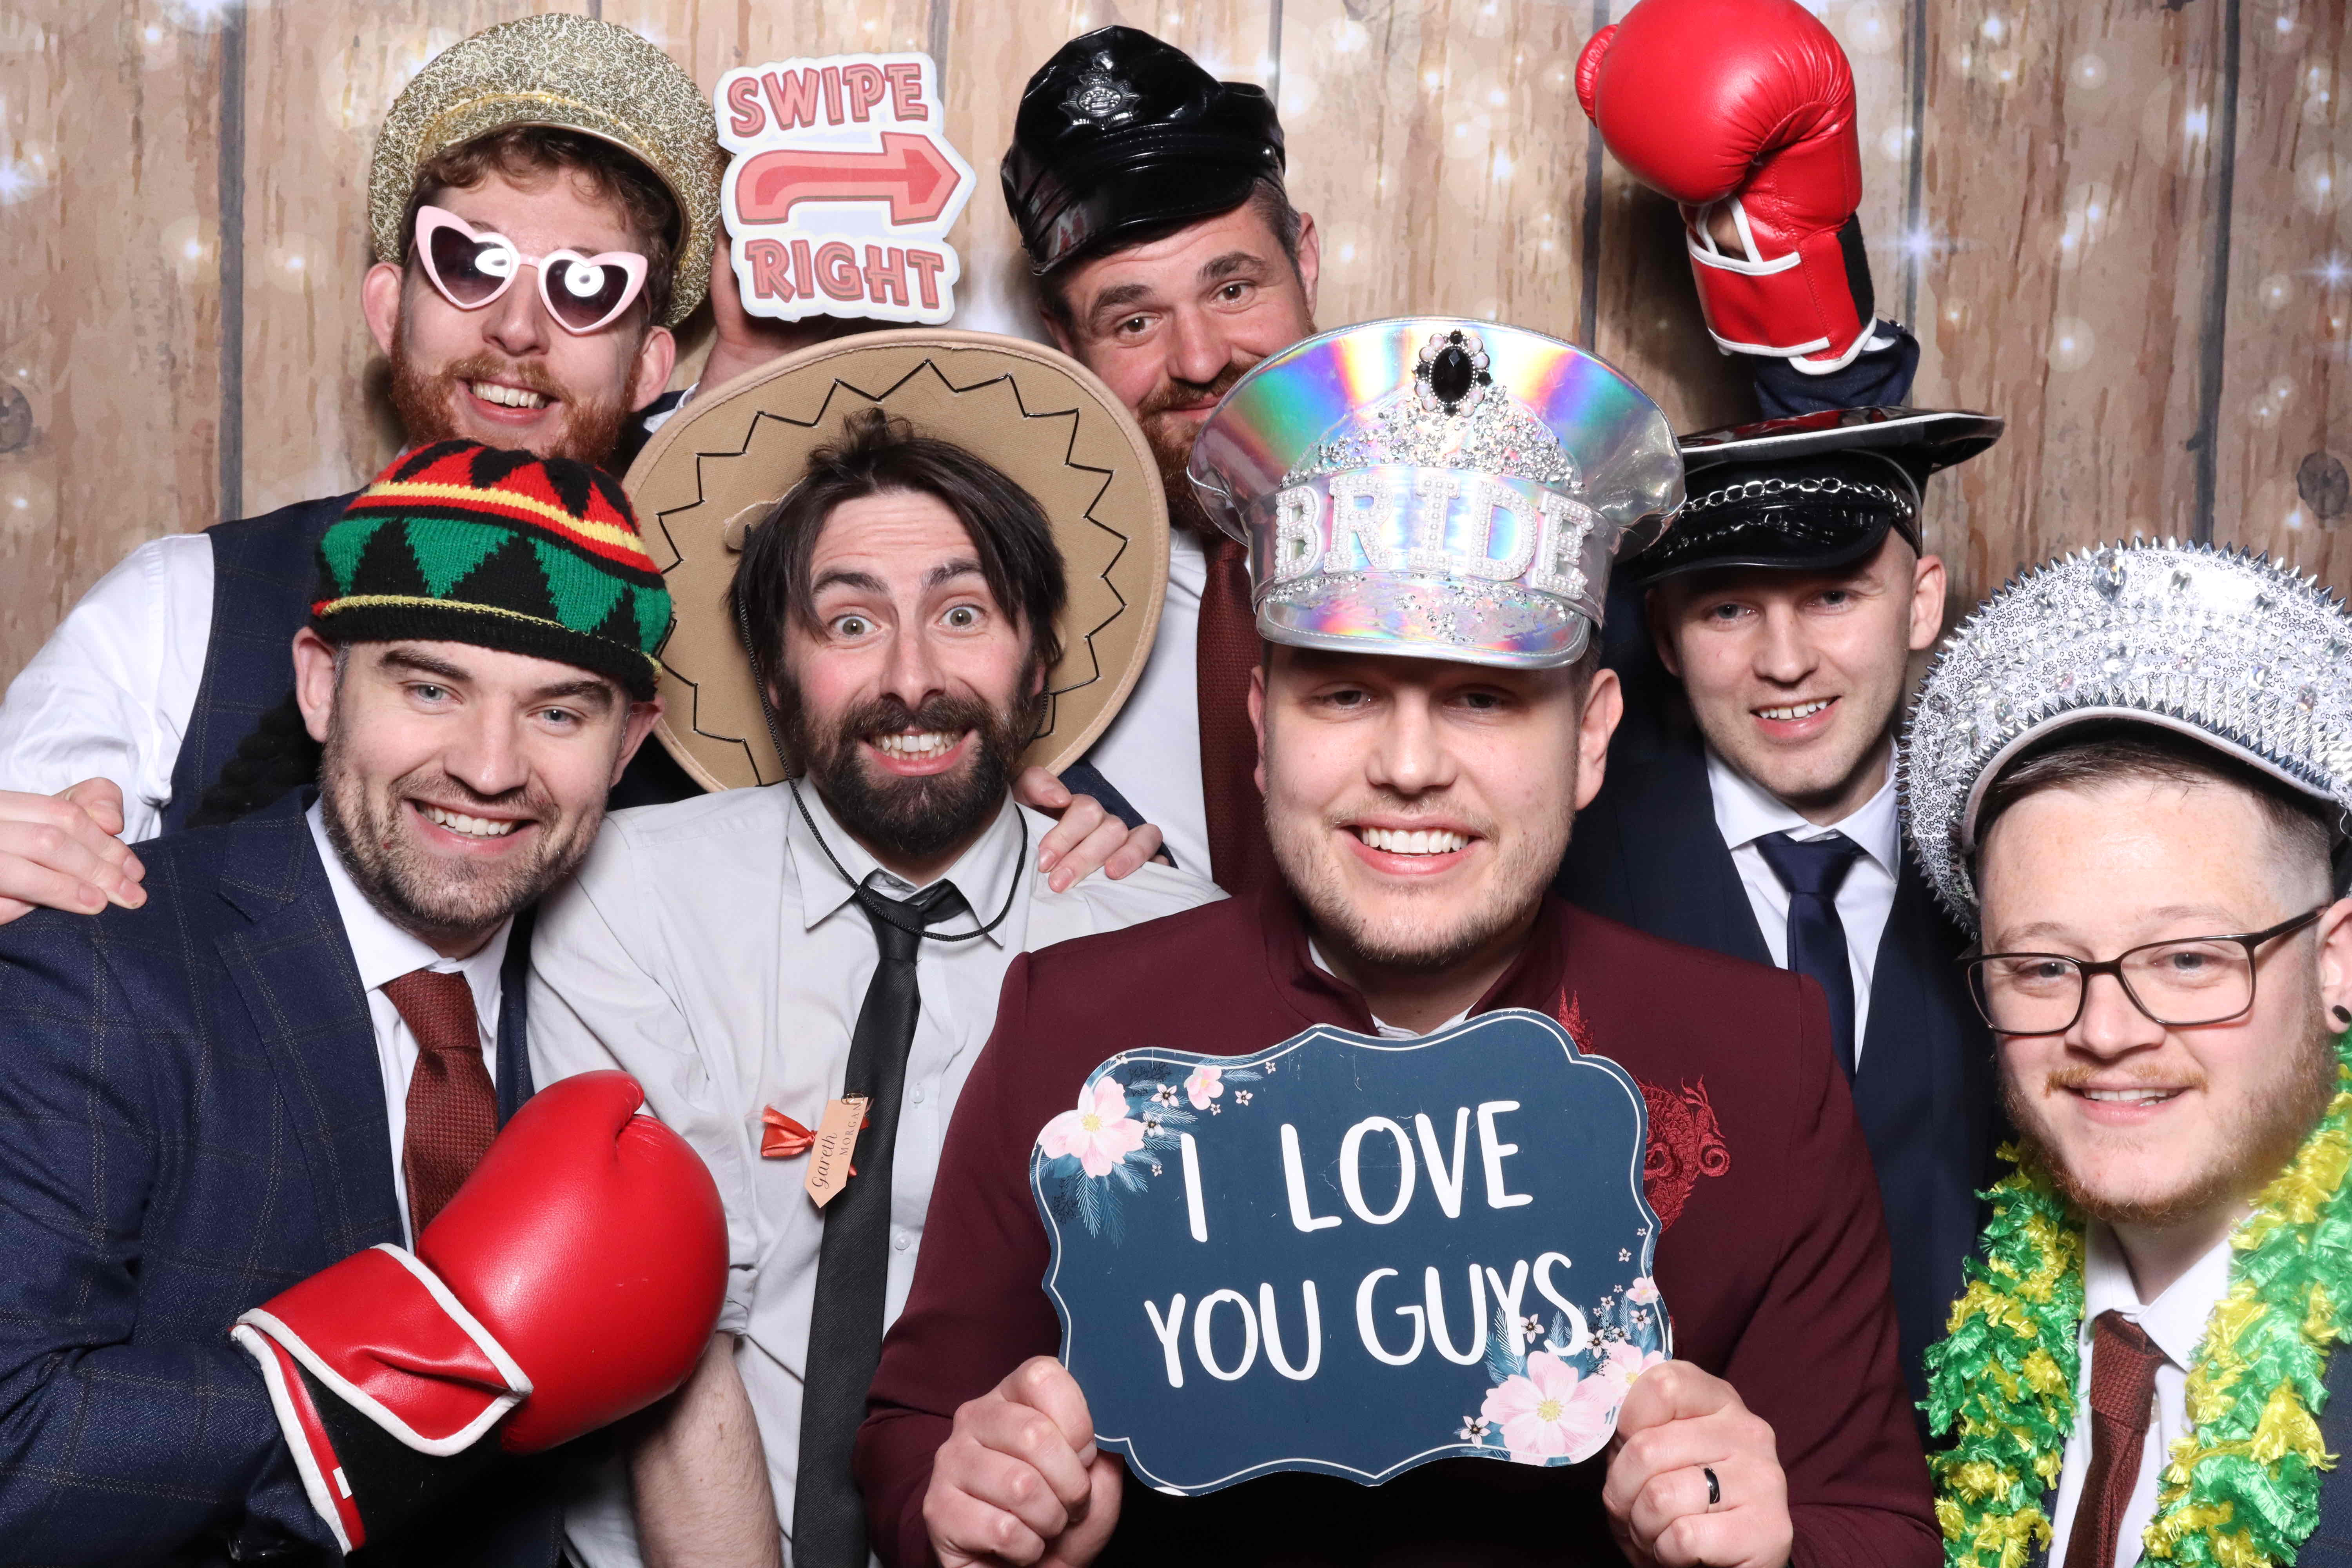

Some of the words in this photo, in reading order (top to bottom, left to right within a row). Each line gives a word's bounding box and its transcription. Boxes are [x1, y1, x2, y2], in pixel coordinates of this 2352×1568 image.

[728, 63, 929, 138] SWIPE
[745, 239, 944, 309] RIGHT
[1274, 473, 1595, 601] BRIDE
[840, 1103, 862, 1156] MORGAN
[1180, 1132, 1208, 1242] I
[1280, 1100, 1534, 1232] LOVE
[1144, 1279, 1321, 1388] YOU
[1356, 1251, 1590, 1366] GUYS
